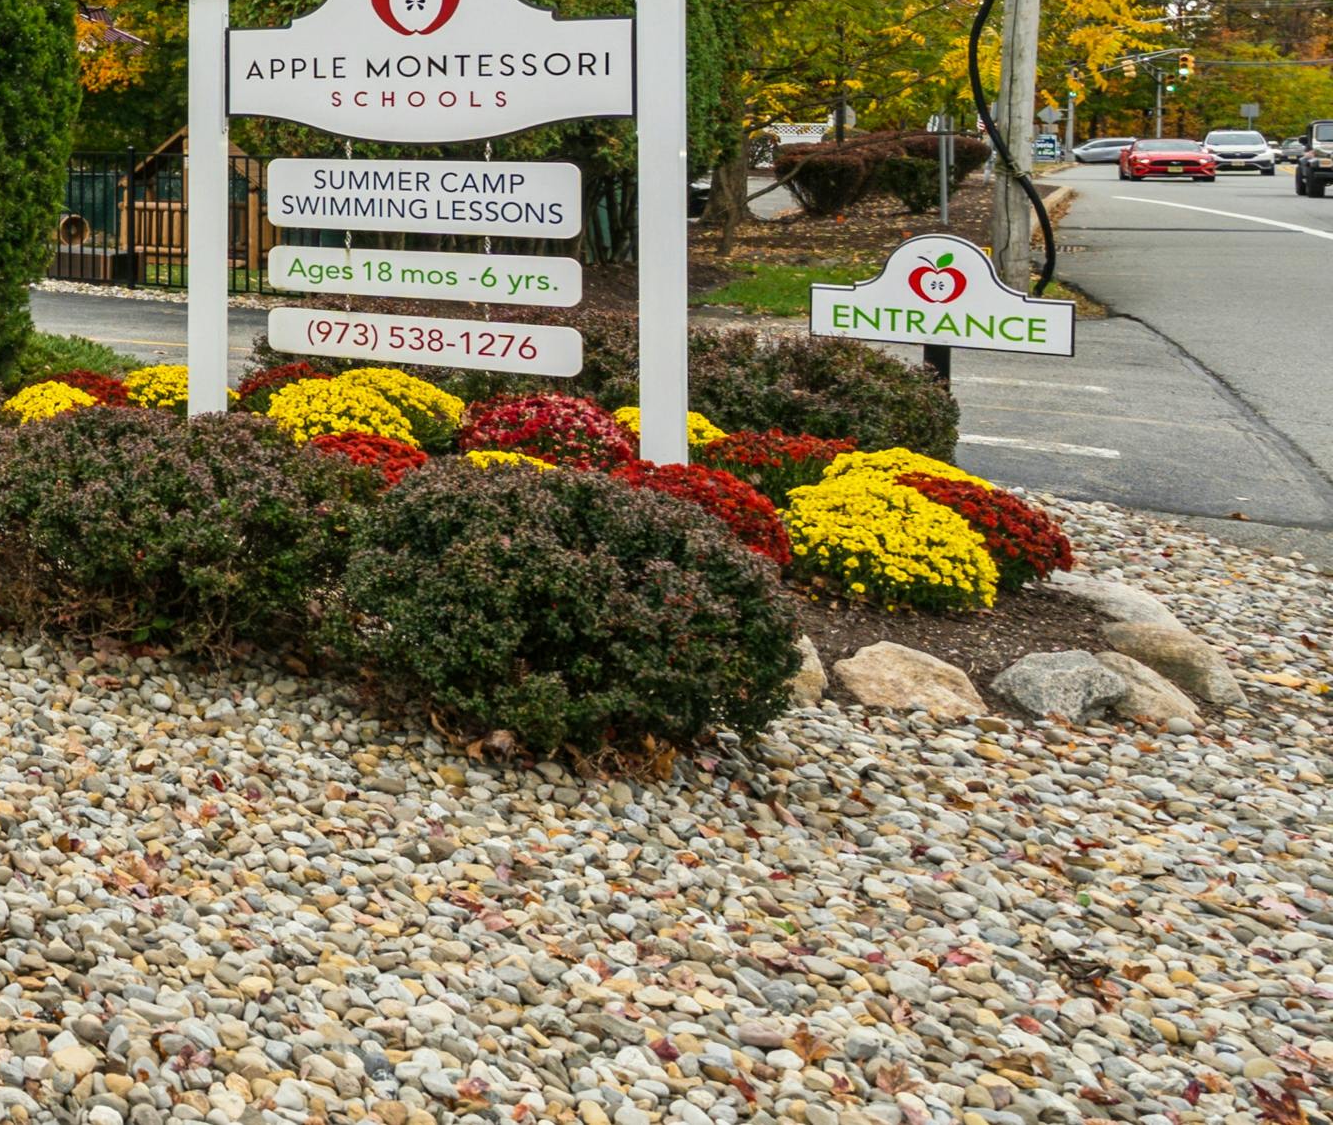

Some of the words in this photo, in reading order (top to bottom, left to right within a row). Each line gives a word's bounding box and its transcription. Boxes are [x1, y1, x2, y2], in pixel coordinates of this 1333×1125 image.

[246, 57, 347, 80] APPLE
[366, 52, 611, 79] MONTESSORI
[331, 91, 508, 108] SCHOOLS
[314, 169, 430, 192] SUMMER
[440, 172, 525, 195] CAMP
[281, 195, 428, 220] SWIMMING
[436, 200, 563, 225] LESSONS
[287, 257, 354, 285] Ages
[362, 260, 393, 283] 18
[401, 268, 458, 286] mos
[507, 274, 559, 295] yrs.
[832, 304, 1047, 344] ENTRANCE
[307, 319, 380, 352] (973)
[388, 325, 538, 360] 538-1276
